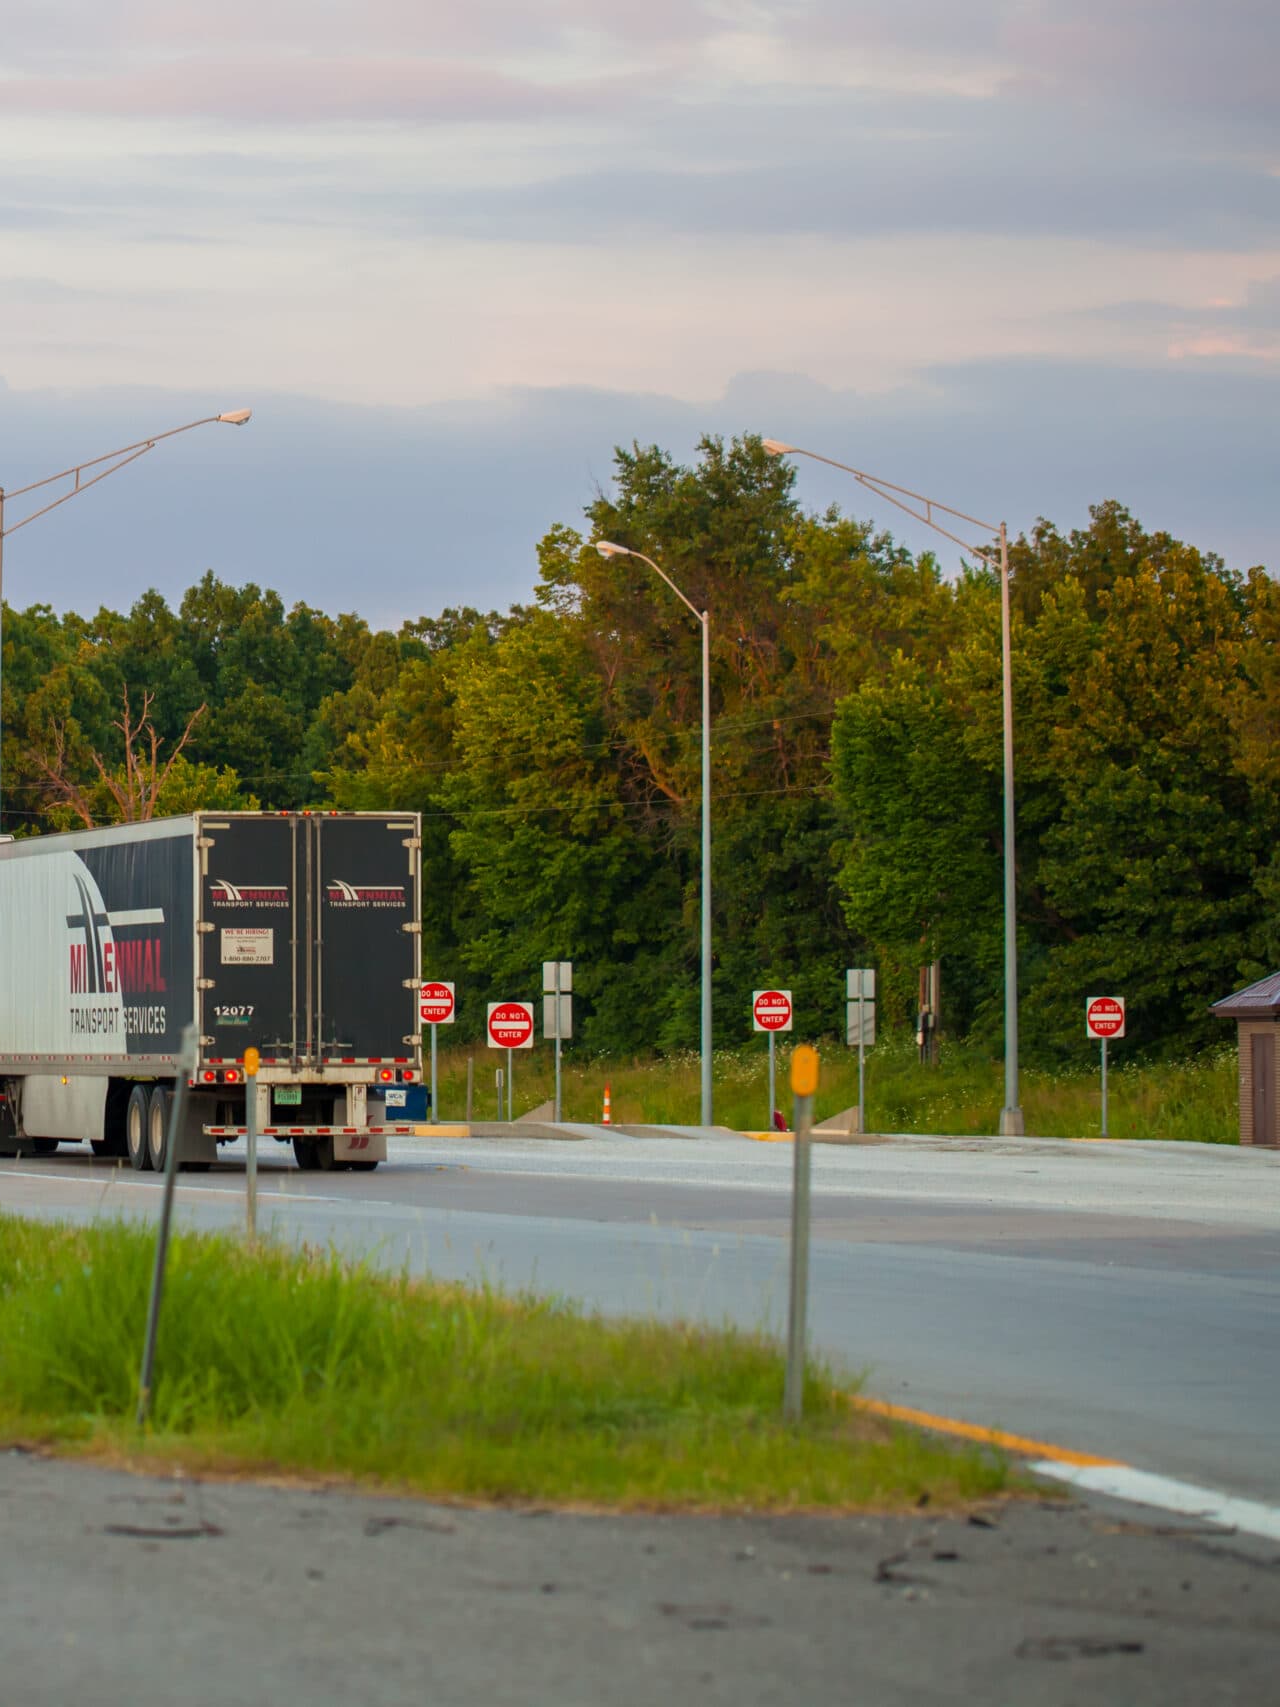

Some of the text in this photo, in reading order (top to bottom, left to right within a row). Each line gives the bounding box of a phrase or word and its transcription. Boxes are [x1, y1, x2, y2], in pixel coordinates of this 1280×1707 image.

[70, 1005, 166, 1034] TRANSPORT SERVICES
[213, 1005, 255, 1017] 12077
